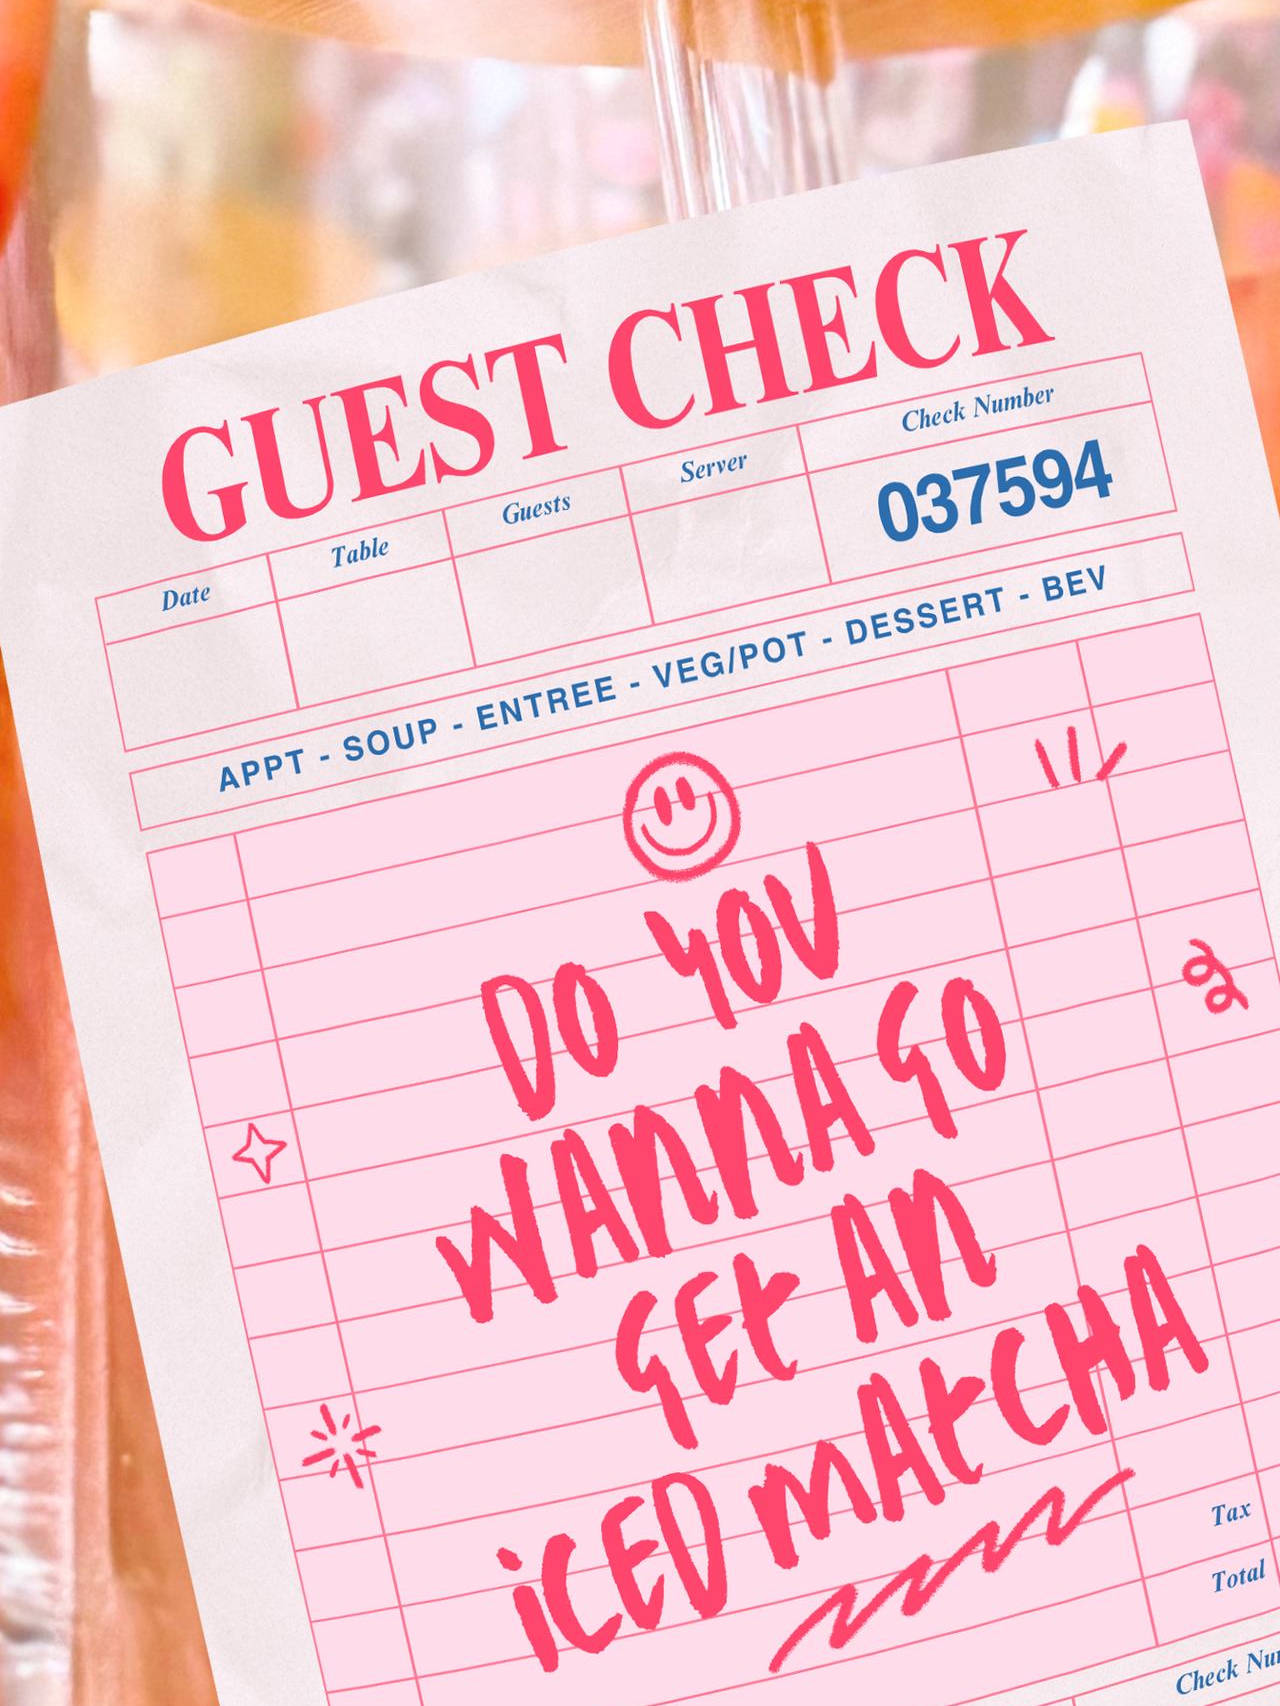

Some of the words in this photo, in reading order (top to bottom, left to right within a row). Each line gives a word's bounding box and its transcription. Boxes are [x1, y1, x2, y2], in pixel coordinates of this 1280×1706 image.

[160, 333, 569, 543] GUEST
[607, 229, 1057, 430] CHECK
[900, 399, 967, 433] Check
[972, 385, 1056, 419] Number
[679, 453, 749, 485] Server
[501, 494, 572, 526] Guests
[876, 437, 1115, 544] 037594
[330, 535, 390, 569] Table
[160, 585, 212, 613] Date
[218, 747, 305, 794] APPT
[341, 717, 438, 763] SOUP
[475, 674, 618, 732] ENTREE
[650, 629, 808, 690] VEG/POT
[844, 585, 1005, 647] DESSERT
[1040, 563, 1106, 603] BEV
[479, 961, 620, 1122] DO
[640, 840, 841, 1031] YOU
[875, 976, 1008, 1140] GO
[1210, 1501, 1252, 1528] Tax
[1210, 1556, 1267, 1594] Total
[1174, 1657, 1240, 1696] Check
